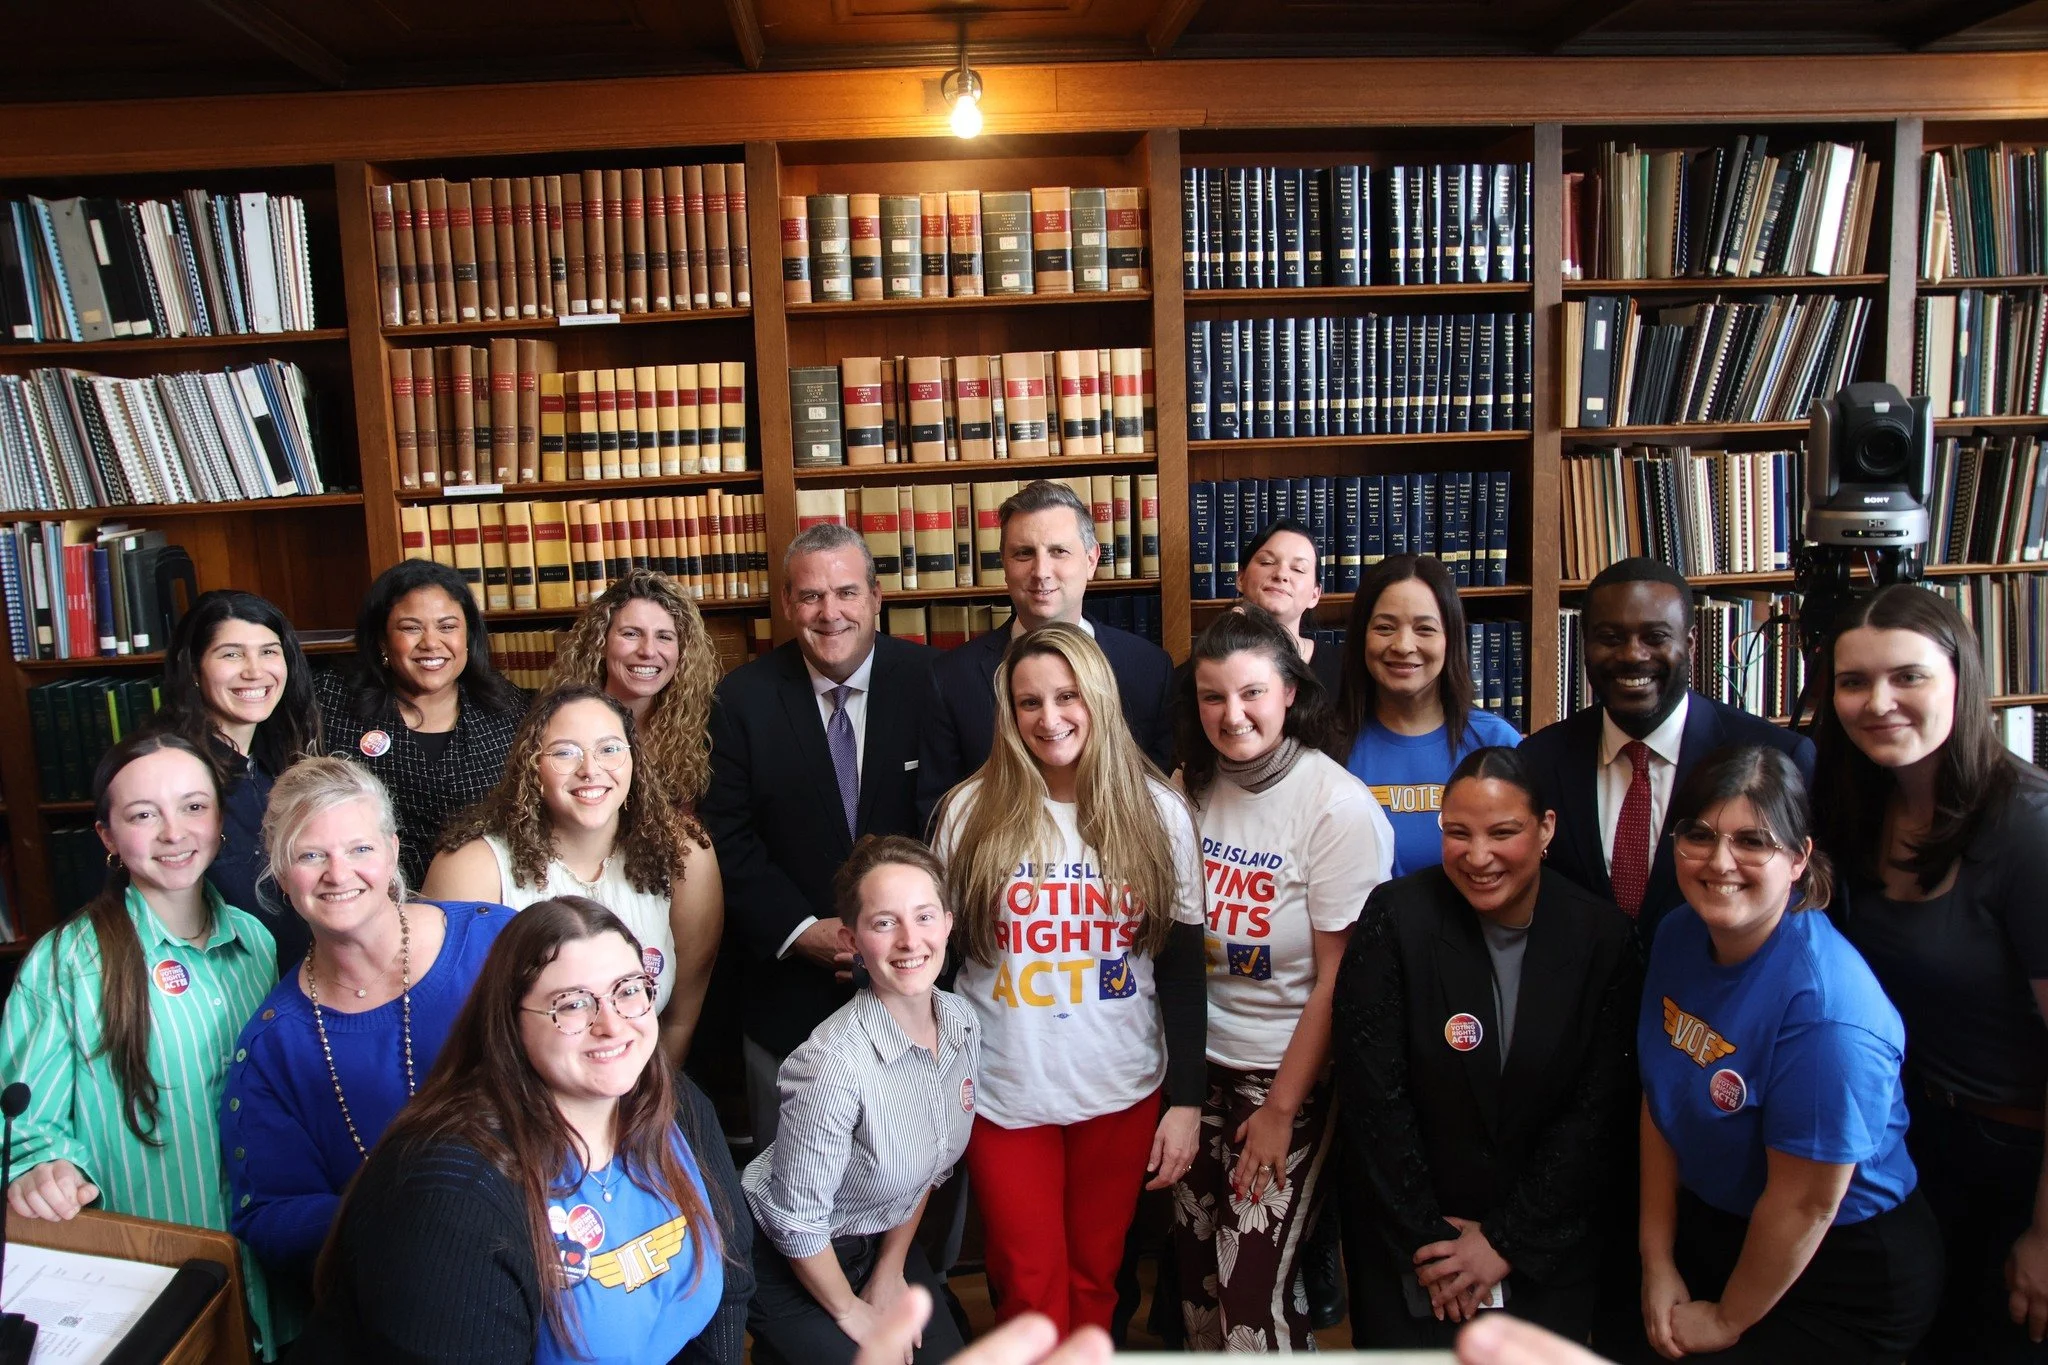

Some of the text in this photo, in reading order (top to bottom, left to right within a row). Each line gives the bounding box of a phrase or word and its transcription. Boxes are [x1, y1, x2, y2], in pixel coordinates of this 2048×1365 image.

[1740, 176, 1756, 220] PROVIDENCE
[1868, 519, 1887, 528] HD
[1390, 786, 1440, 810] VOTE
[1223, 846, 1282, 870] ISLAND
[1204, 860, 1275, 902] TING
[992, 882, 1144, 916] OTING
[993, 920, 1140, 953] RIGHTS
[992, 959, 1094, 1008] ACT
